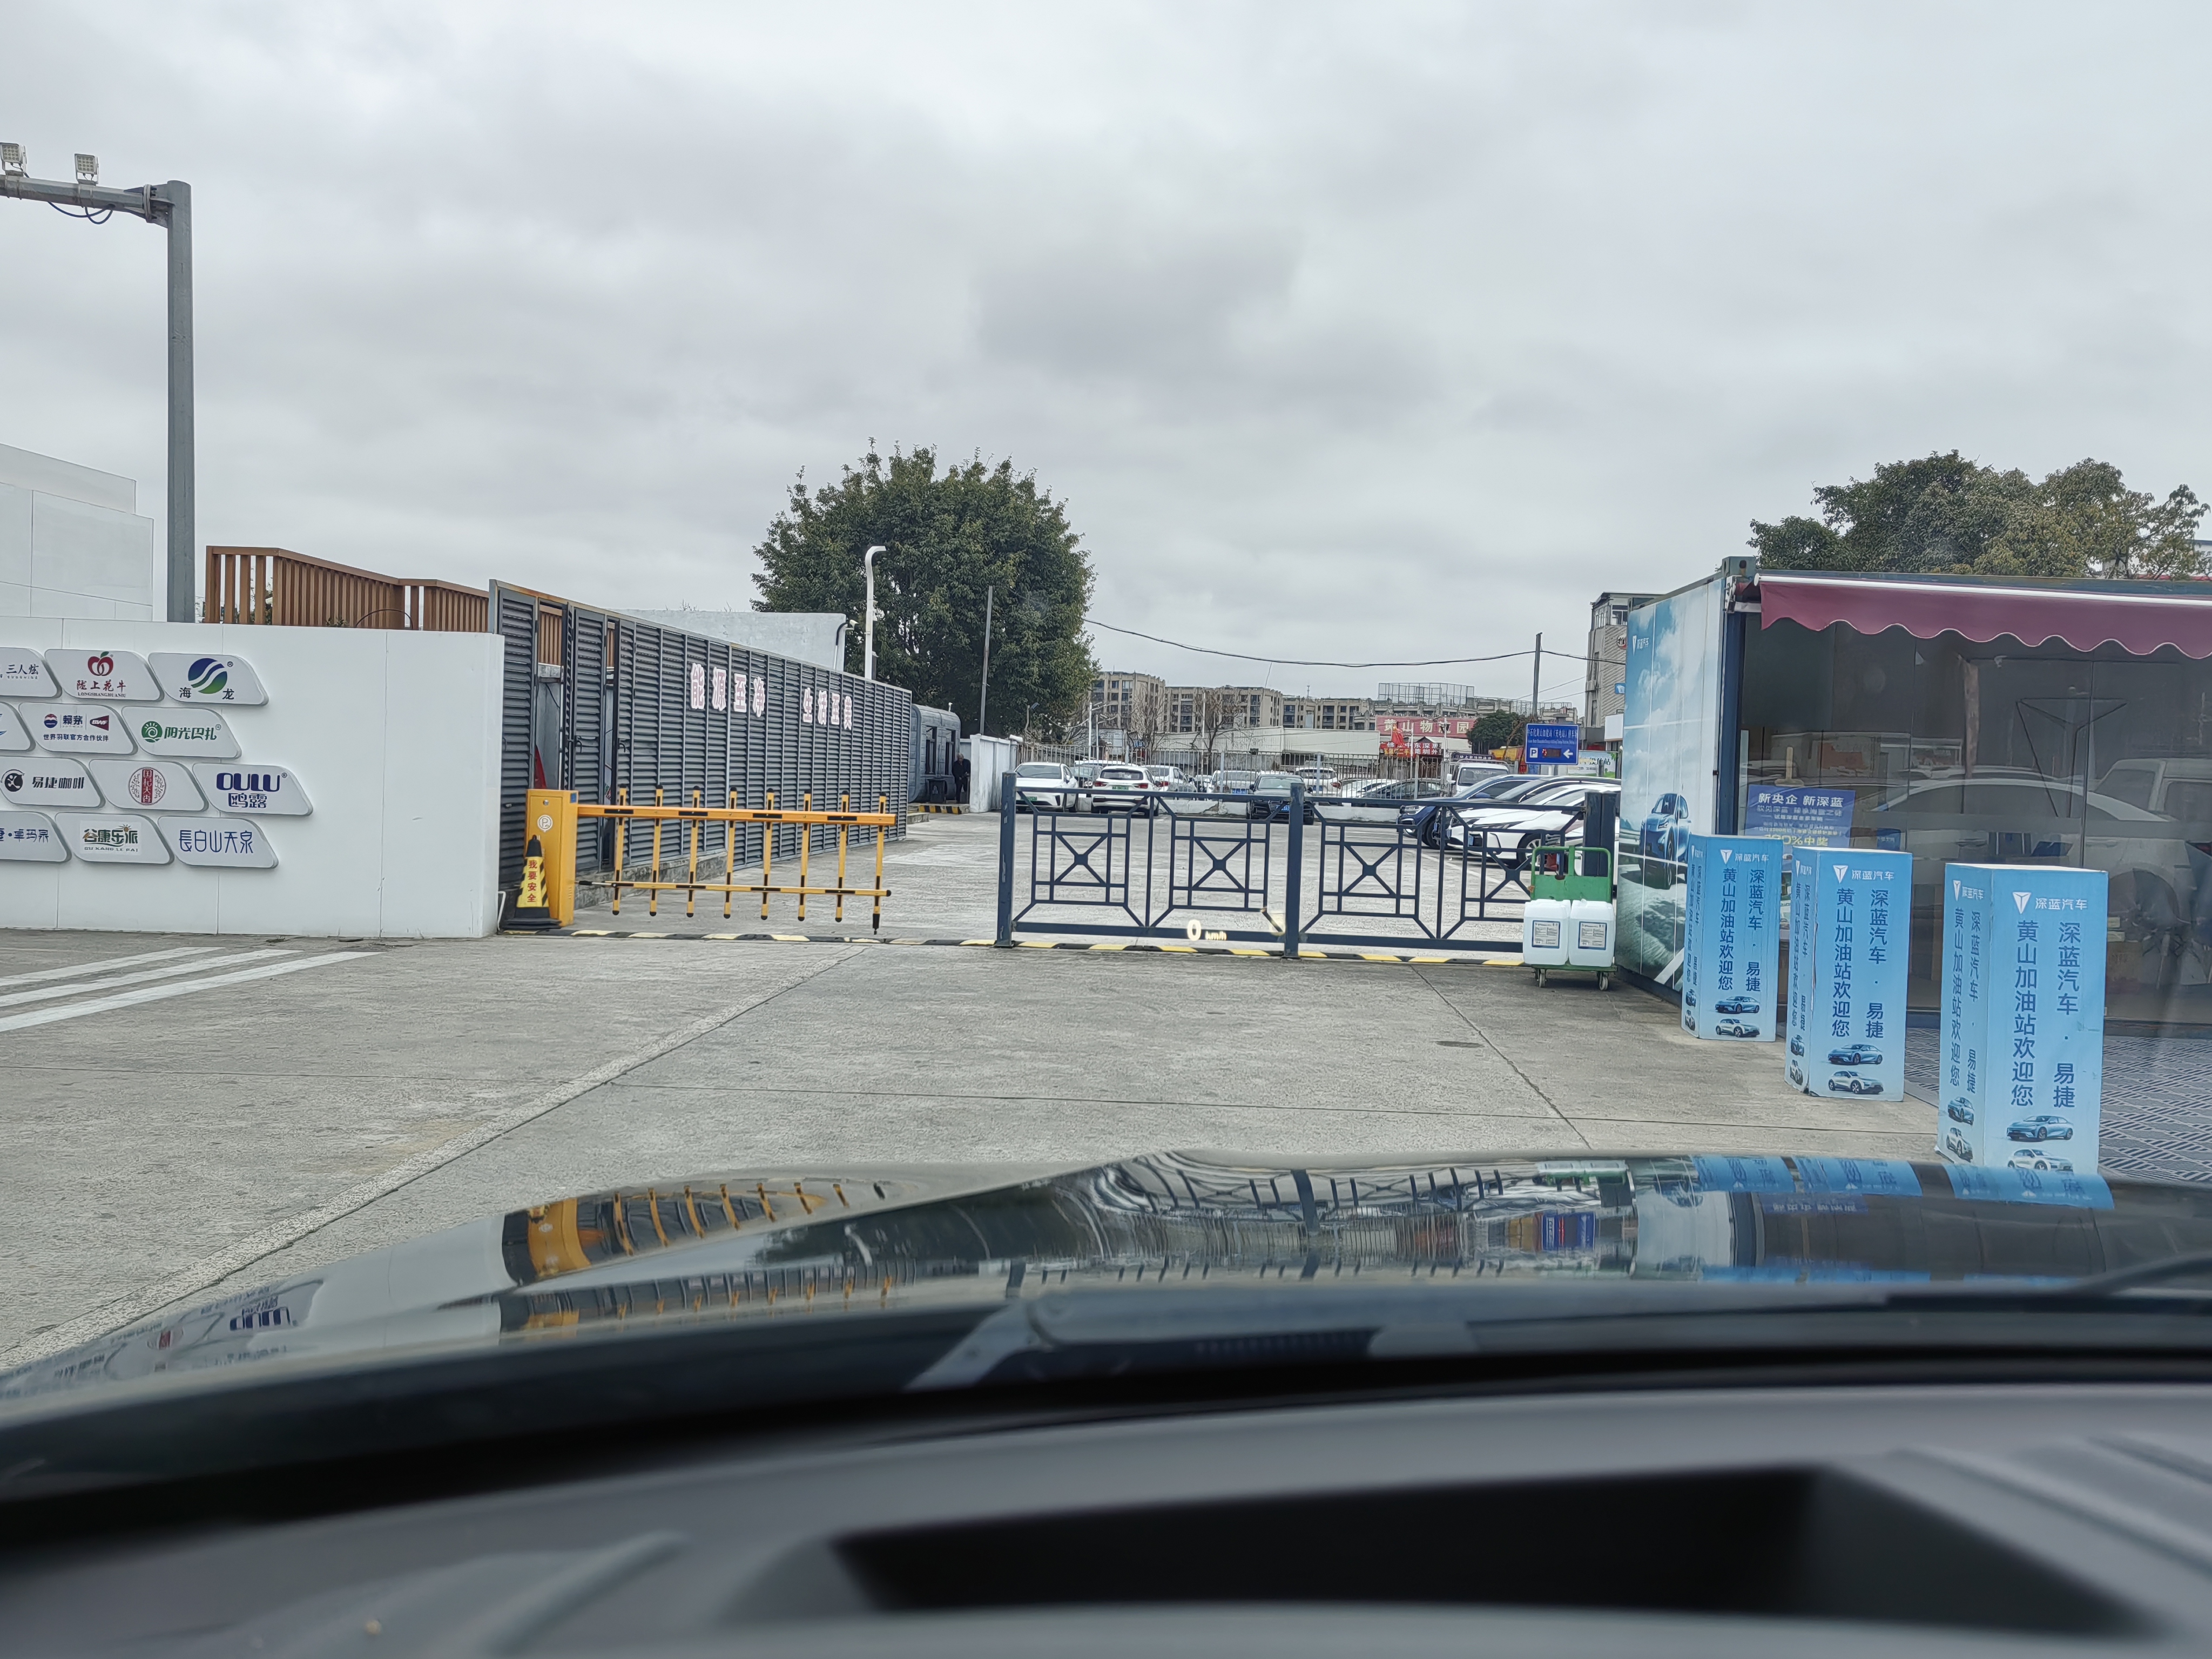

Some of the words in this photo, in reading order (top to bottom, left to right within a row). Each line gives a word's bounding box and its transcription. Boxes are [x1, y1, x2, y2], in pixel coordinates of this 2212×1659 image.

[77, 679, 126, 692] 陇上花牛
[691, 663, 765, 717] 能源至净
[803, 687, 852, 730] 生活至美
[164, 727, 217, 740] 阳光巴扎
[32, 777, 84, 789] 易捷咖啡
[217, 773, 280, 792] OULU
[1758, 793, 1798, 805] 新央企
[1803, 795, 1844, 808] 新深蓝
[527, 860, 538, 902] 我要安全
[1852, 869, 1894, 881] 深蓝汽车
[2035, 898, 2088, 911] 深蓝汽车
[1718, 867, 1737, 990] 黄山加油站欢迎您
[1832, 887, 1855, 1037] 黄山加油站欢迎您
[1950, 907, 1965, 1087] 黄山加油站欢迎您
[2011, 920, 2039, 1107] 黄山加油站欢迎您
